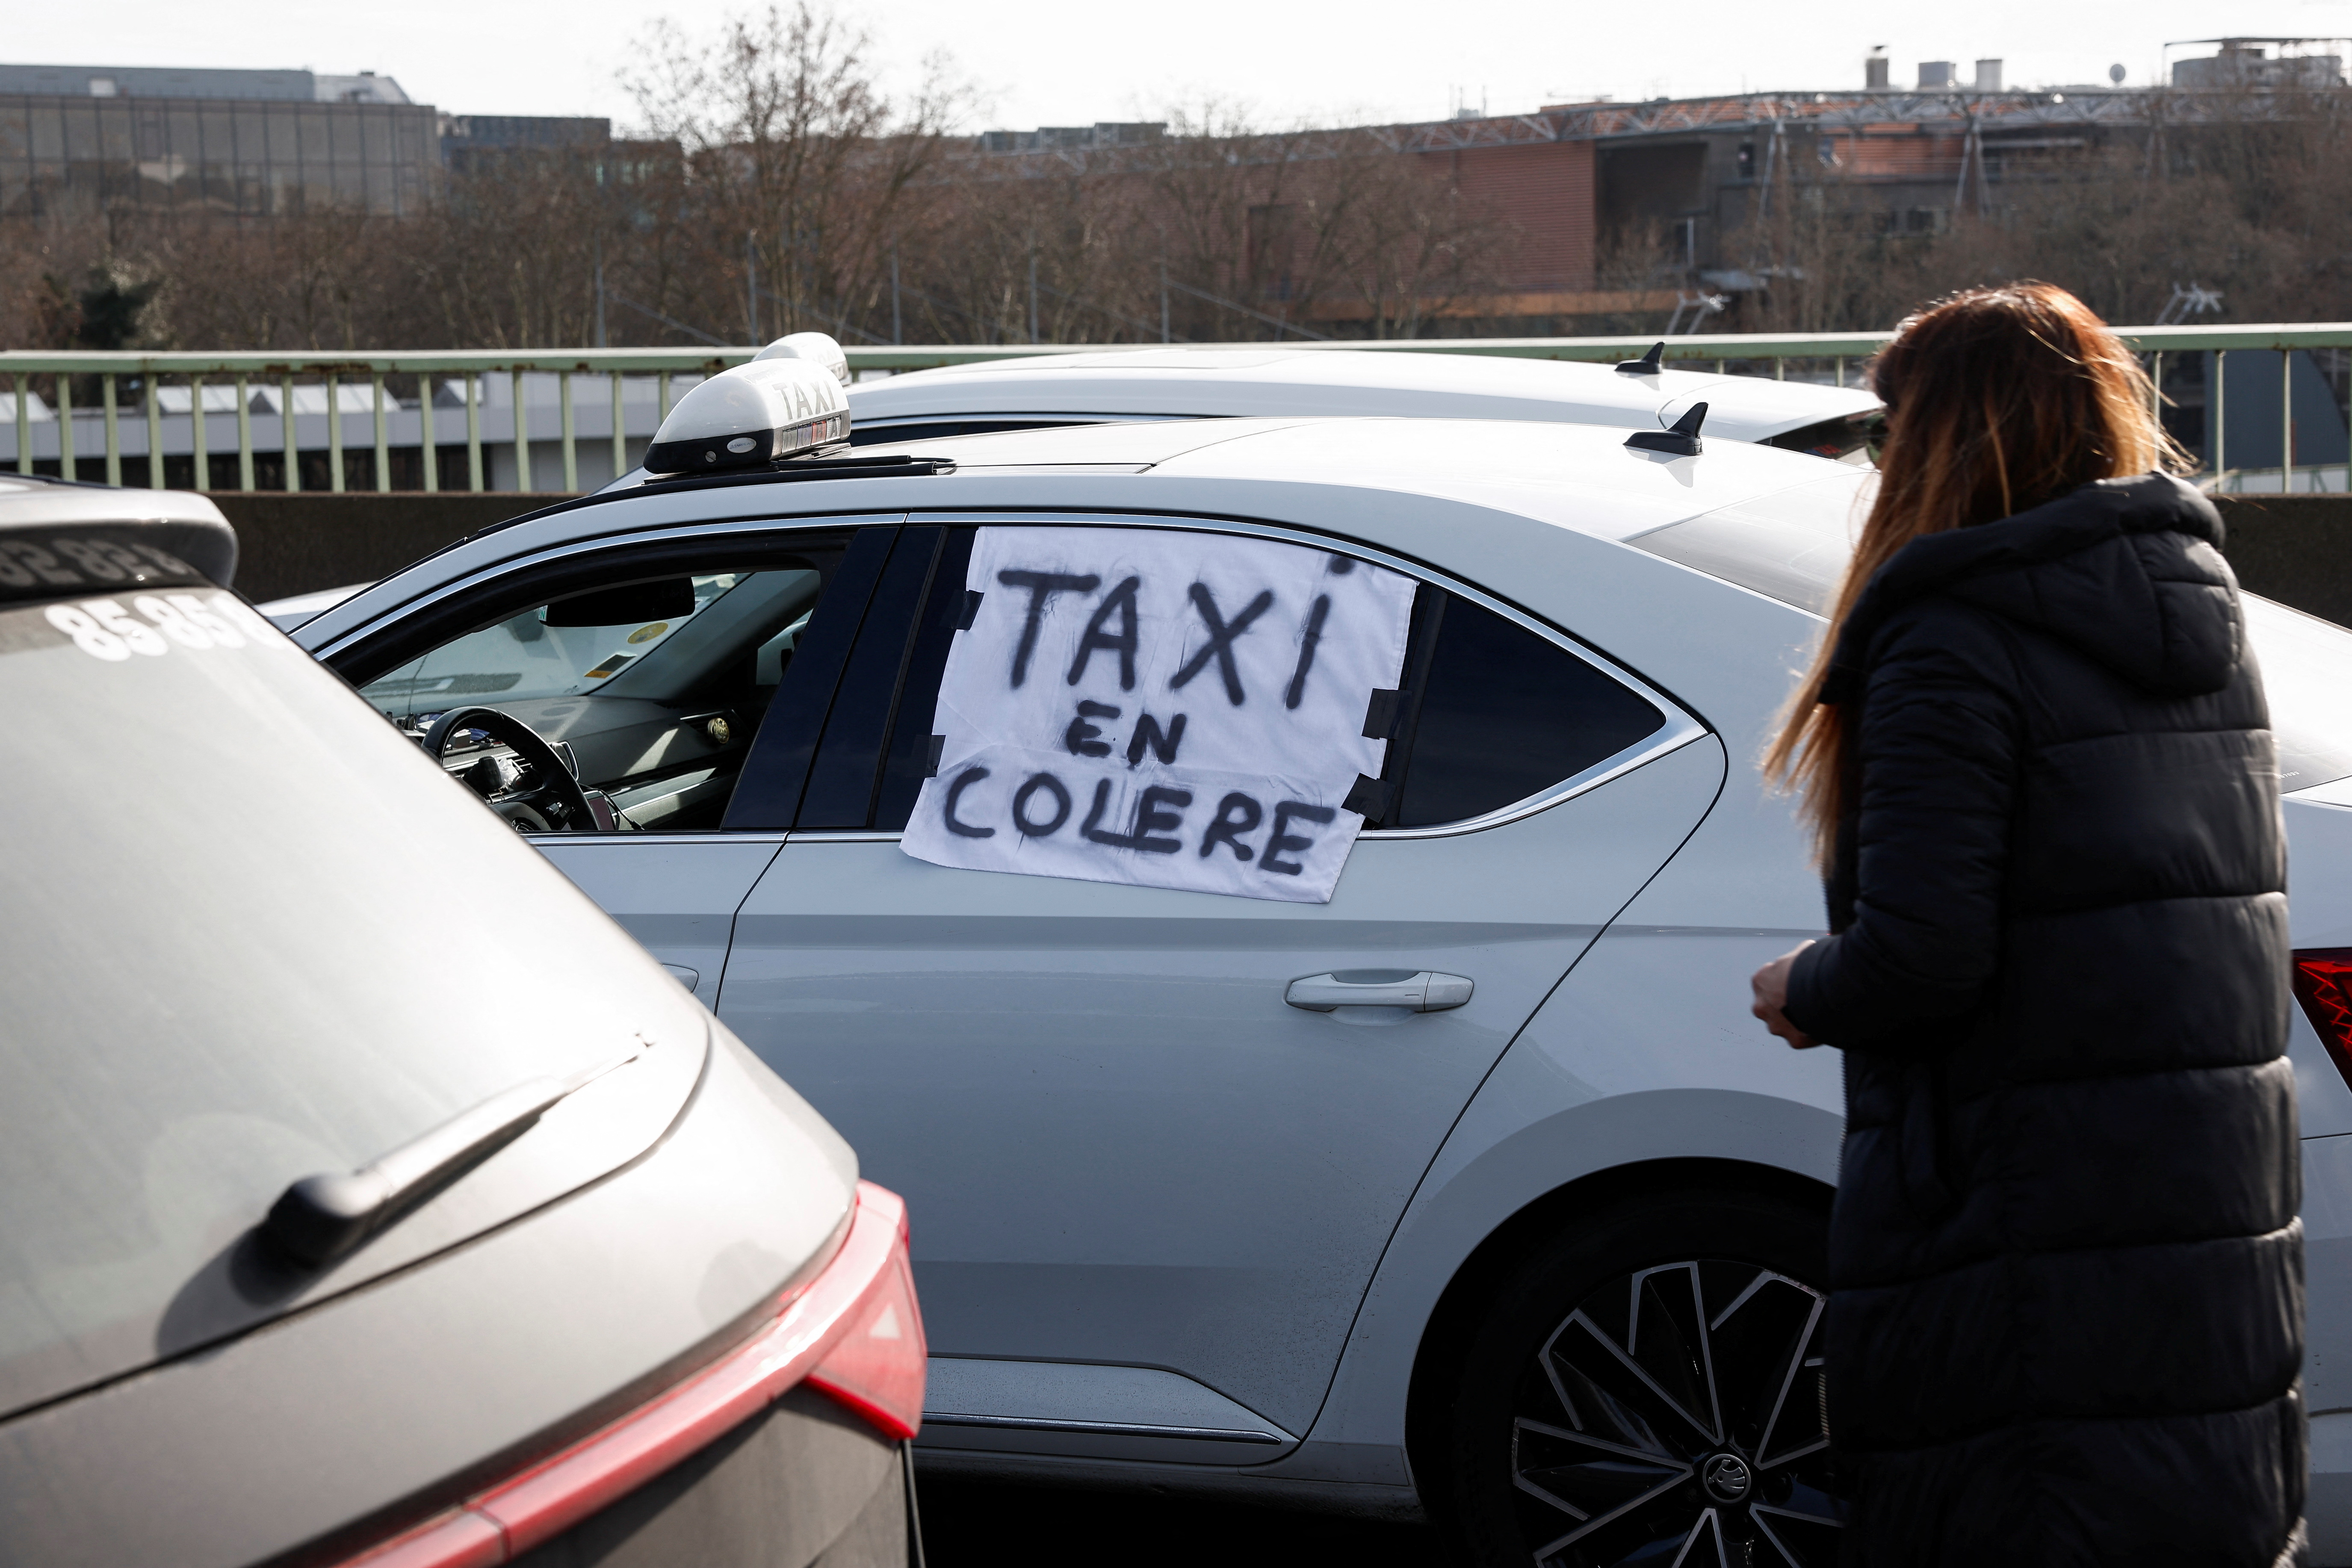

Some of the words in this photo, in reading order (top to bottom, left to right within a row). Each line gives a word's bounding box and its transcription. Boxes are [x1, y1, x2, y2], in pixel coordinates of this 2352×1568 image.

[771, 379, 836, 420] TAXI
[1065, 700, 1187, 768] EN
[944, 766, 1337, 876] COLERE
